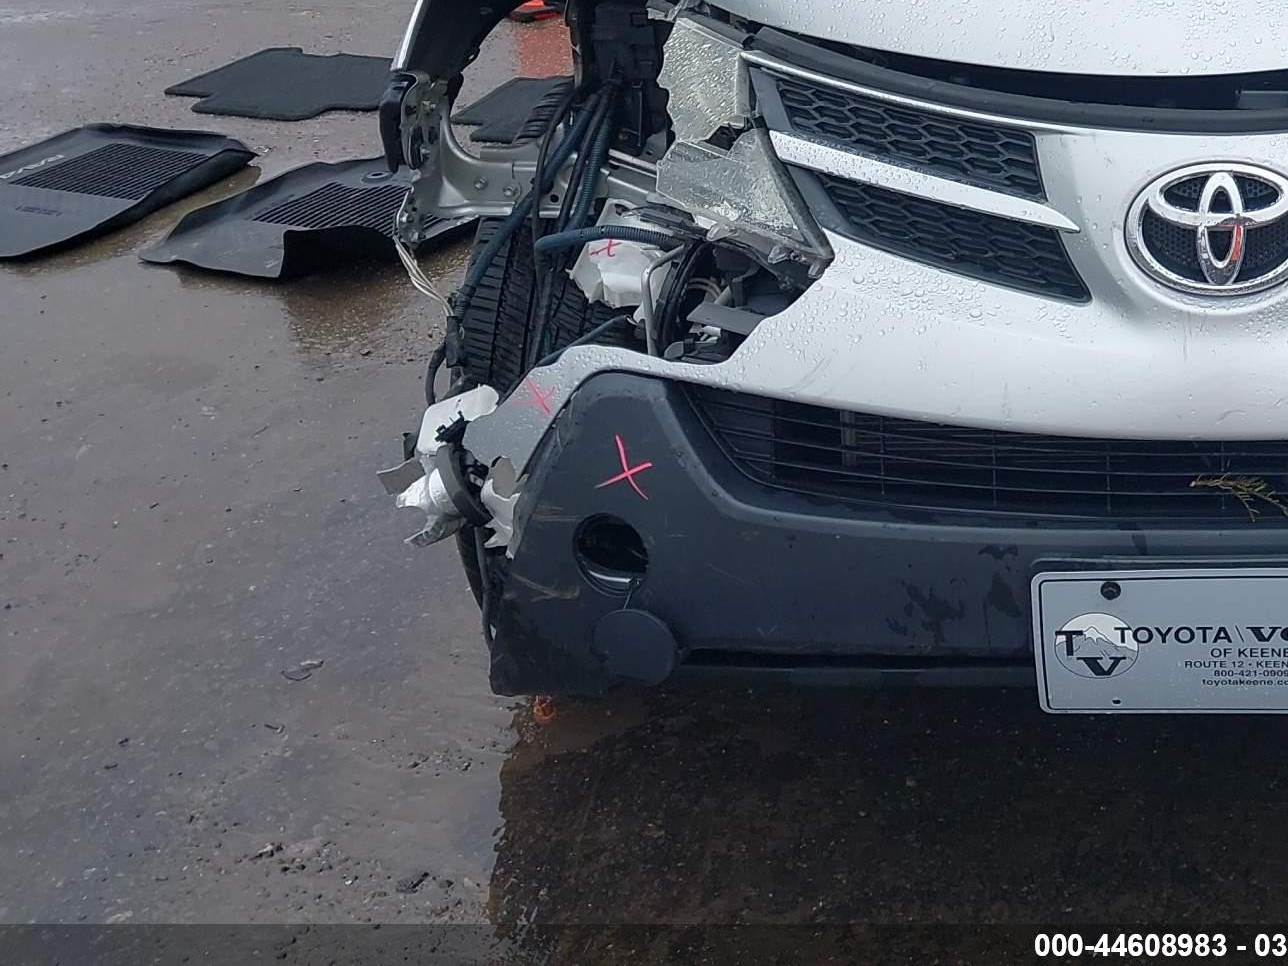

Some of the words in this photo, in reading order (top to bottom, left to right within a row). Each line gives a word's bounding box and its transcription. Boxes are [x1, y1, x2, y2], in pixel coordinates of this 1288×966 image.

[1114, 625, 1233, 644] TOYOTA
[1210, 647, 1233, 658] OF
[1184, 660, 1228, 669] ROUTE
[1231, 660, 1245, 669] 12
